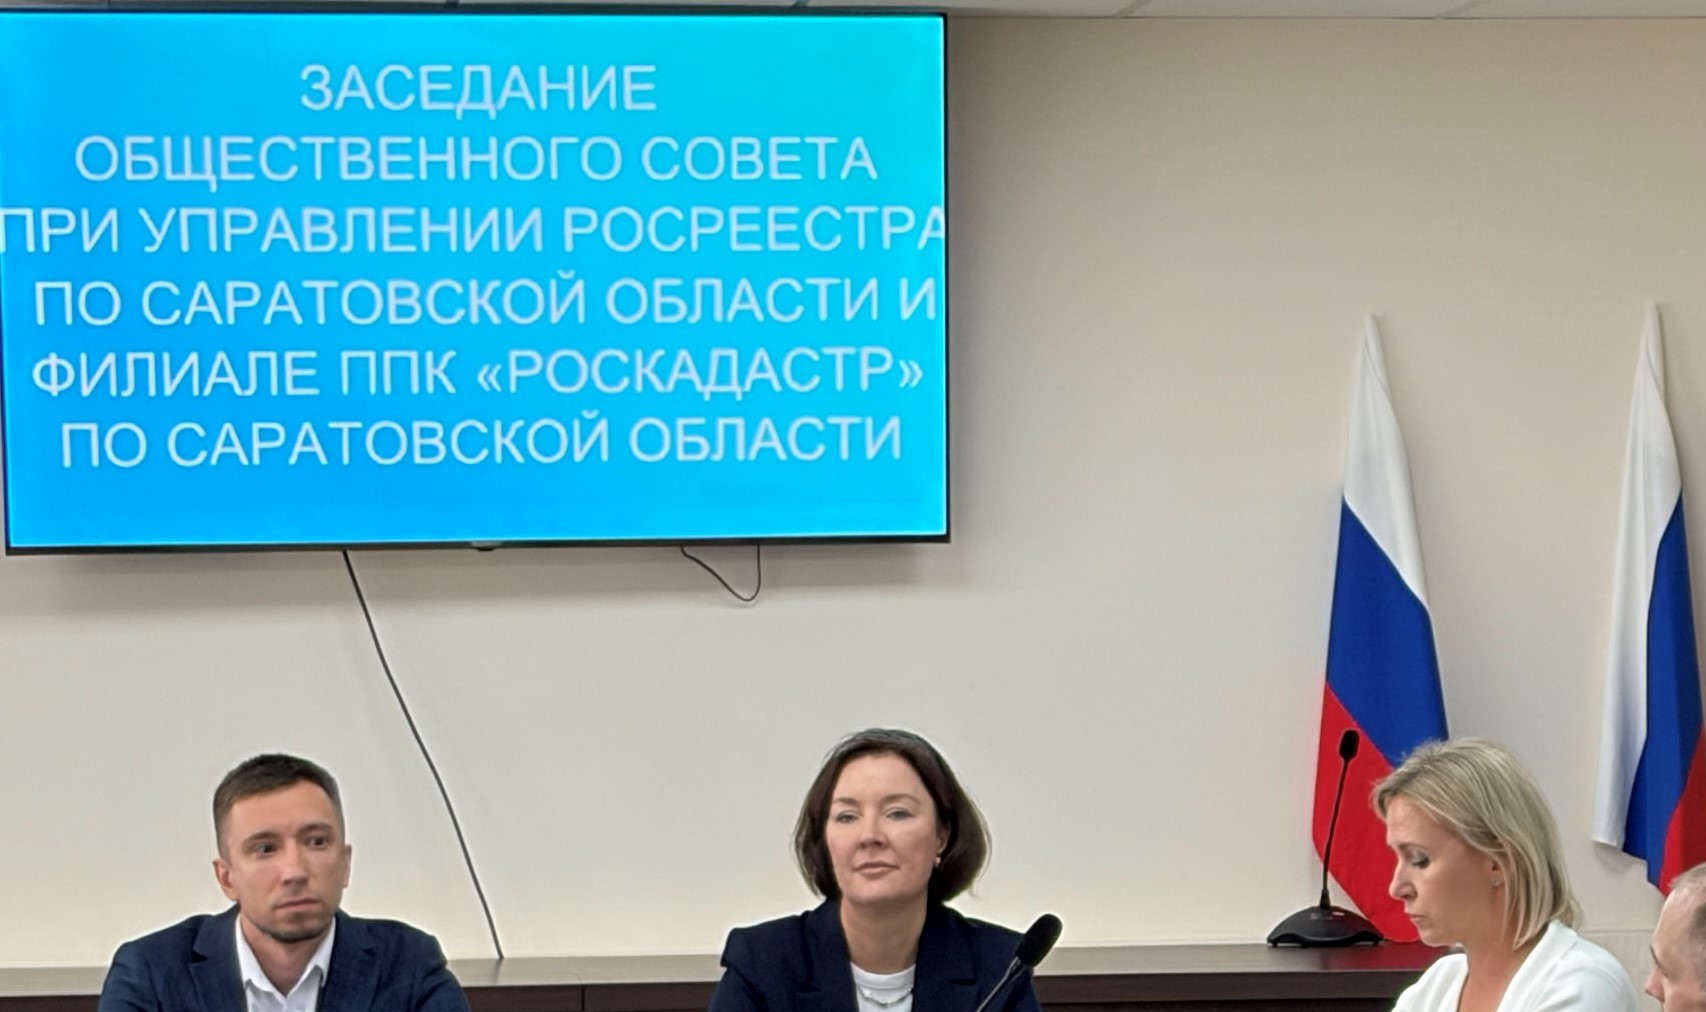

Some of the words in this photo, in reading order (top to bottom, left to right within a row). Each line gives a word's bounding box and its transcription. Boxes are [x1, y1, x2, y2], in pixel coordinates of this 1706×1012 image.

[301, 64, 656, 119] ЗАСЕДАНИЕ
[75, 136, 621, 192] ОБЩЕСТВЕННОГО
[641, 136, 877, 179] СОВЕТА
[0, 207, 118, 252] ПРИ
[138, 207, 542, 252] УПРАВЛЕНИИ
[564, 205, 944, 252] РОСРЕЕСТРА
[35, 280, 121, 325] ПО
[142, 271, 584, 325] САРАТОВСКОЙ
[606, 277, 878, 323] ОБЛАСТИ
[899, 277, 936, 321] И
[32, 351, 319, 396] ФИЛИАЛЕ
[341, 350, 455, 394] ППК
[477, 346, 923, 400] «РОСКАДАСТР»
[61, 422, 146, 467] ПО
[167, 411, 608, 466] САРАТОВСКОЙ
[629, 416, 901, 461] ОБЛАСТИ
